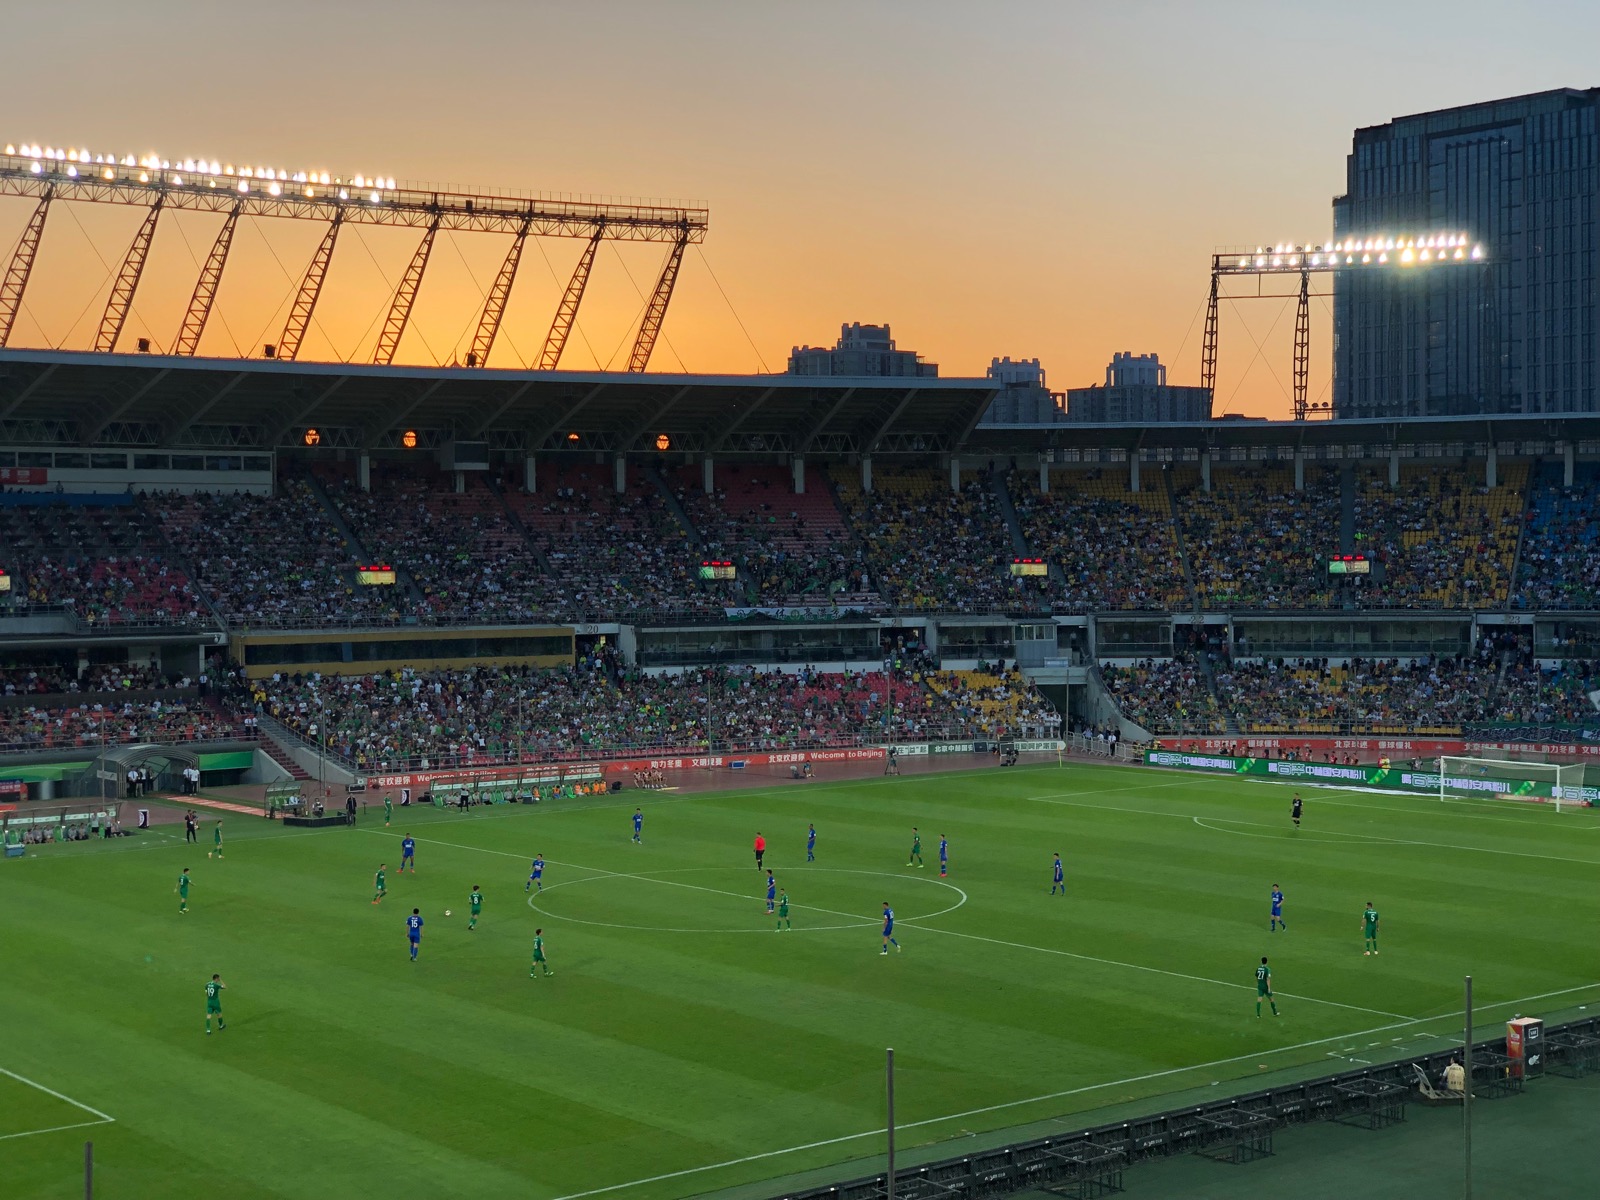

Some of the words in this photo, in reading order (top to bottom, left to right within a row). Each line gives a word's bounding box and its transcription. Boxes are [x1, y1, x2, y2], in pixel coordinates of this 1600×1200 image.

[1190, 616, 1205, 624] 22
[1508, 616, 1520, 624] 23
[587, 625, 599, 633] 20
[1541, 744, 1576, 754] 助力冬奥
[1581, 746, 1600, 755] 文明
[768, 753, 805, 763] 北京欢迎你
[810, 751, 845, 760] Welcome
[857, 750, 883, 759] Beijing
[651, 759, 682, 769] 助力冬奥
[411, 919, 418, 928] 15
[1256, 970, 1265, 980] 27
[207, 987, 215, 997] 19
